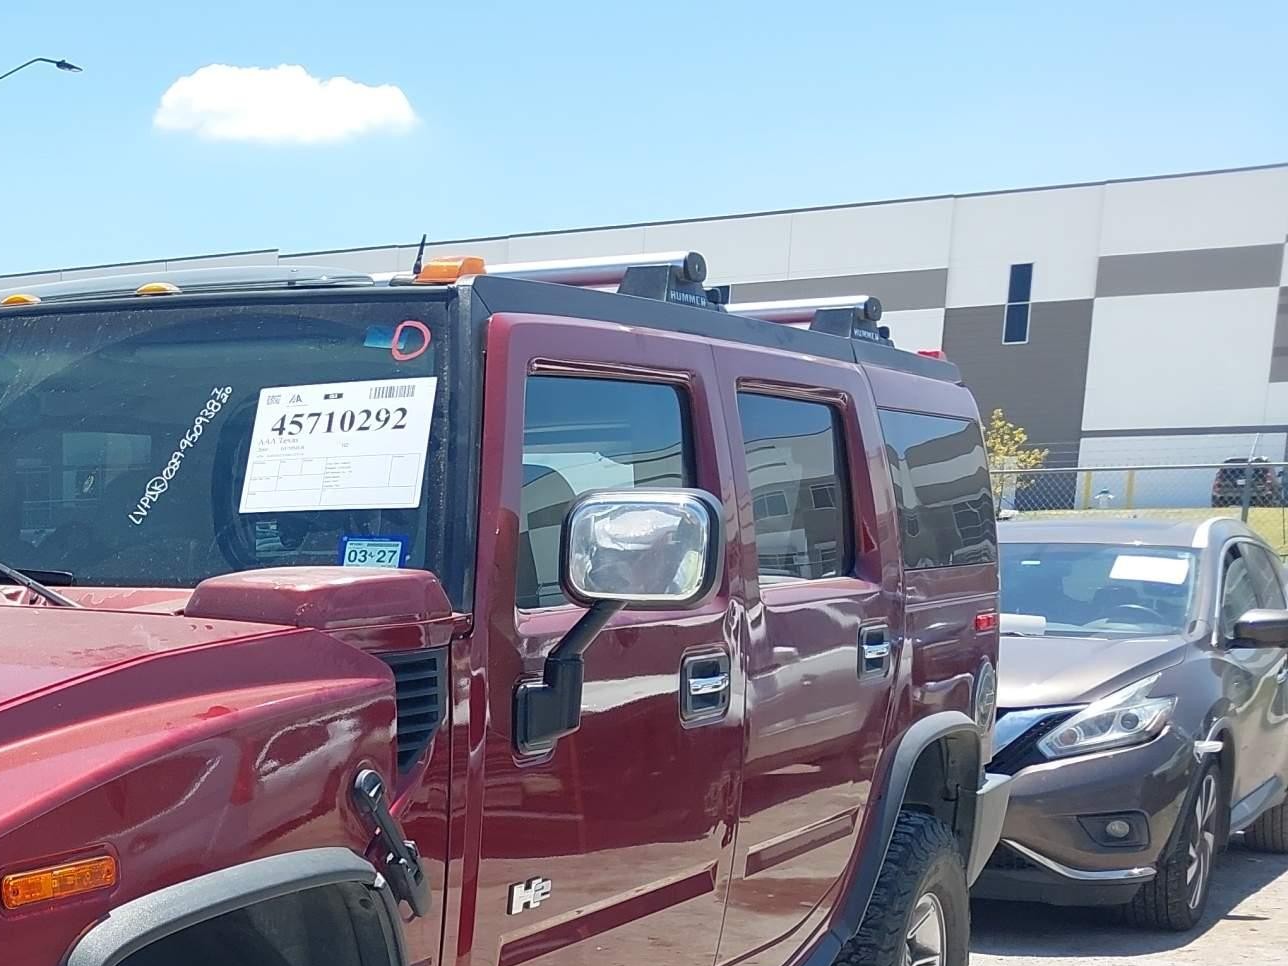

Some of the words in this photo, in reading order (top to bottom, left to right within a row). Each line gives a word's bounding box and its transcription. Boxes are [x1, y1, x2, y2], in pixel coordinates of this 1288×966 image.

[670, 290, 707, 307] HUMMER
[271, 407, 408, 436] 45710292
[348, 549, 368, 563] 03
[376, 549, 398, 563] 27
[507, 876, 552, 916] H2
